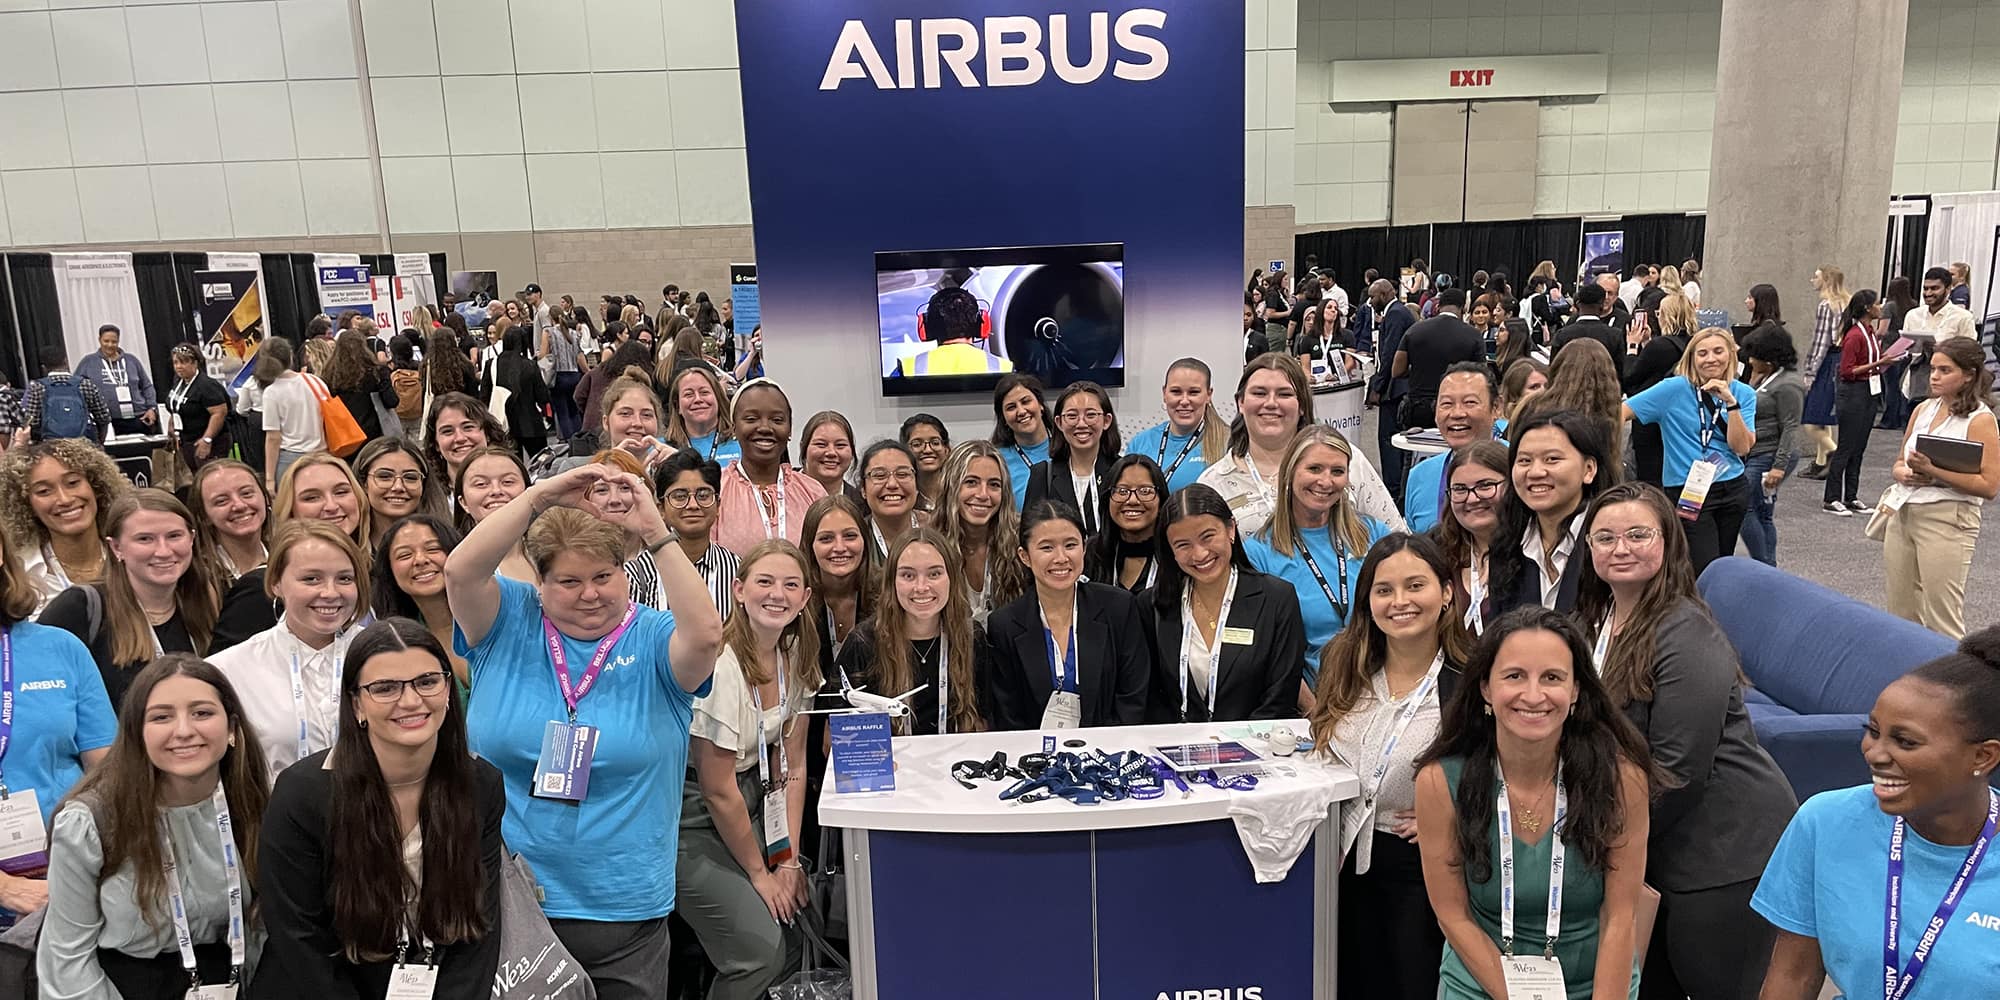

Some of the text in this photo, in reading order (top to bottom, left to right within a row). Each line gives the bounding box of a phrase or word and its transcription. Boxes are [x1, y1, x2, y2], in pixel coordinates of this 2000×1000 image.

[819, 8, 1169, 90] AIRBUS
[1450, 69, 1494, 87] EXIT
[376, 312, 391, 328] CSL
[1324, 414, 1361, 430] Novanta
[20, 679, 67, 692] AIRBUS
[574, 673, 593, 698] AIRBUS
[2, 691, 12, 725] AIRBUS
[1120, 757, 1147, 777] AIRBUS
[1890, 816, 1904, 861] AIRBUS
[1944, 836, 1988, 905] Inclusion and Diversity
[1887, 876, 1900, 951] Inclusion and Diversity
[1914, 916, 1944, 963] AIRBUS
[492, 956, 530, 997] We23
[546, 959, 569, 985] KOHLER
